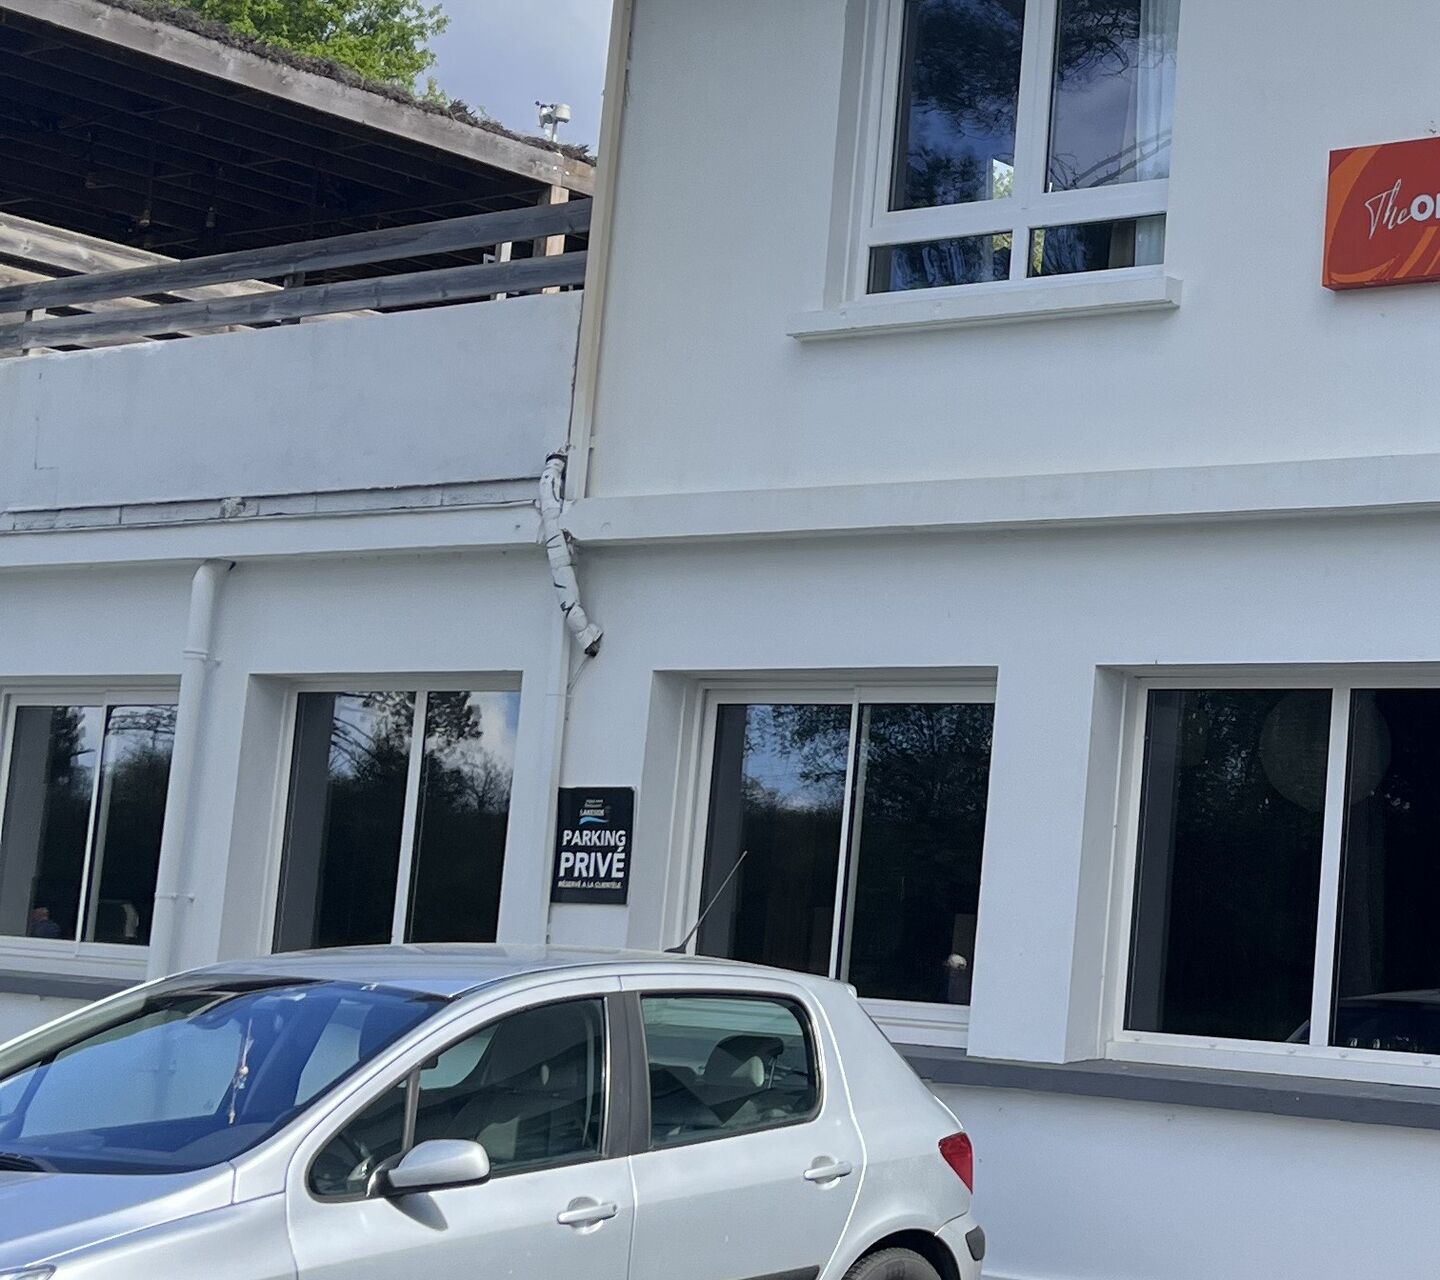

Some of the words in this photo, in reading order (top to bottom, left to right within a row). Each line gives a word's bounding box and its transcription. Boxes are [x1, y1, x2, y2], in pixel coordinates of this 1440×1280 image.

[1364, 177, 1411, 240] The
[562, 830, 626, 846] PARKING
[559, 847, 626, 878] PRIVÉ
